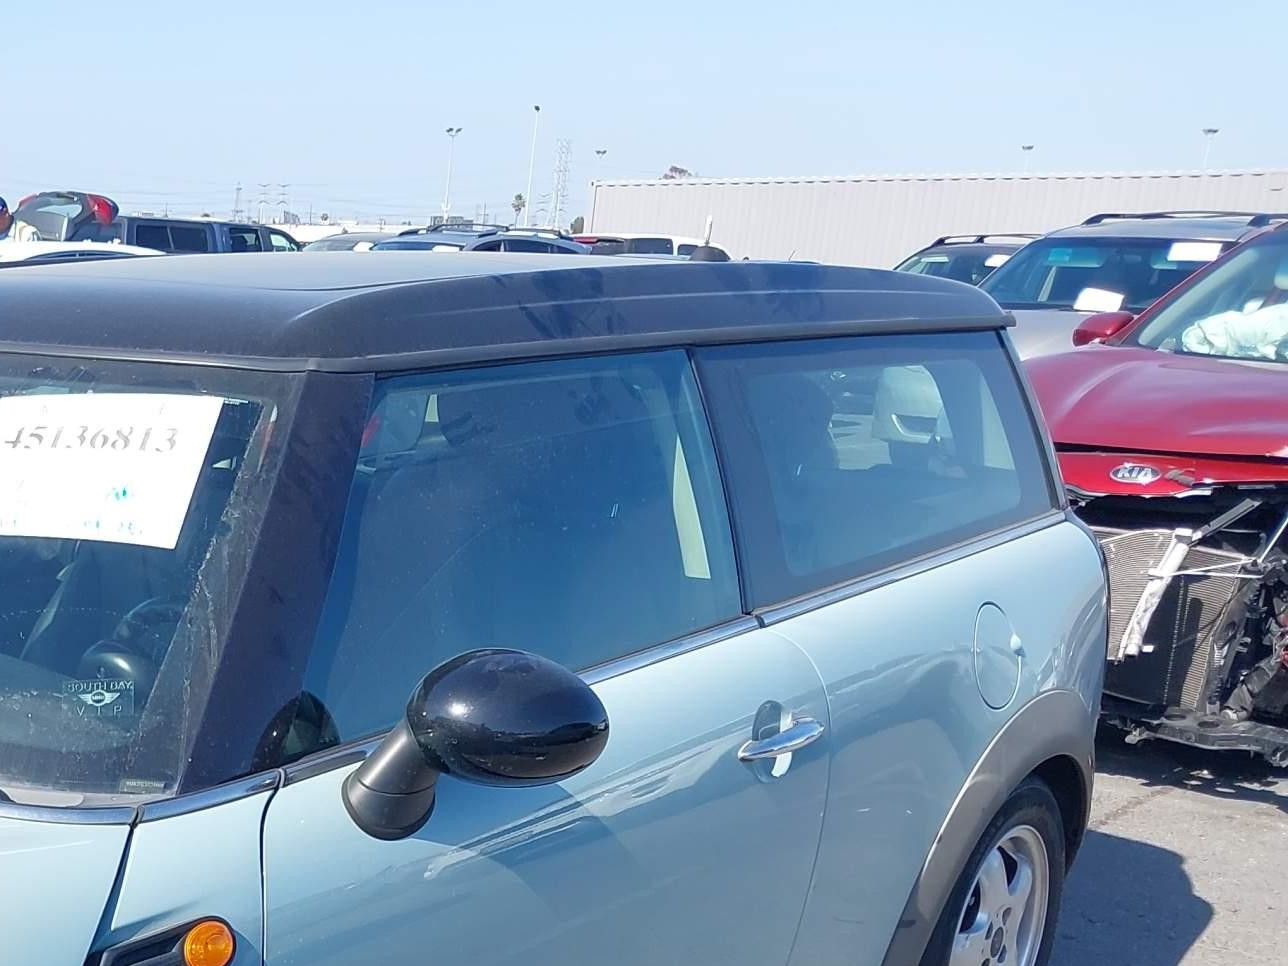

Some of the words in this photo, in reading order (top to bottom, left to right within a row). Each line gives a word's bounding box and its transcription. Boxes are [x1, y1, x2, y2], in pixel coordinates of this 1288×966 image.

[4, 424, 179, 453] 45136813
[1117, 466, 1153, 480] KIA
[67, 681, 107, 692] SOUTH
[110, 680, 133, 691] BAY
